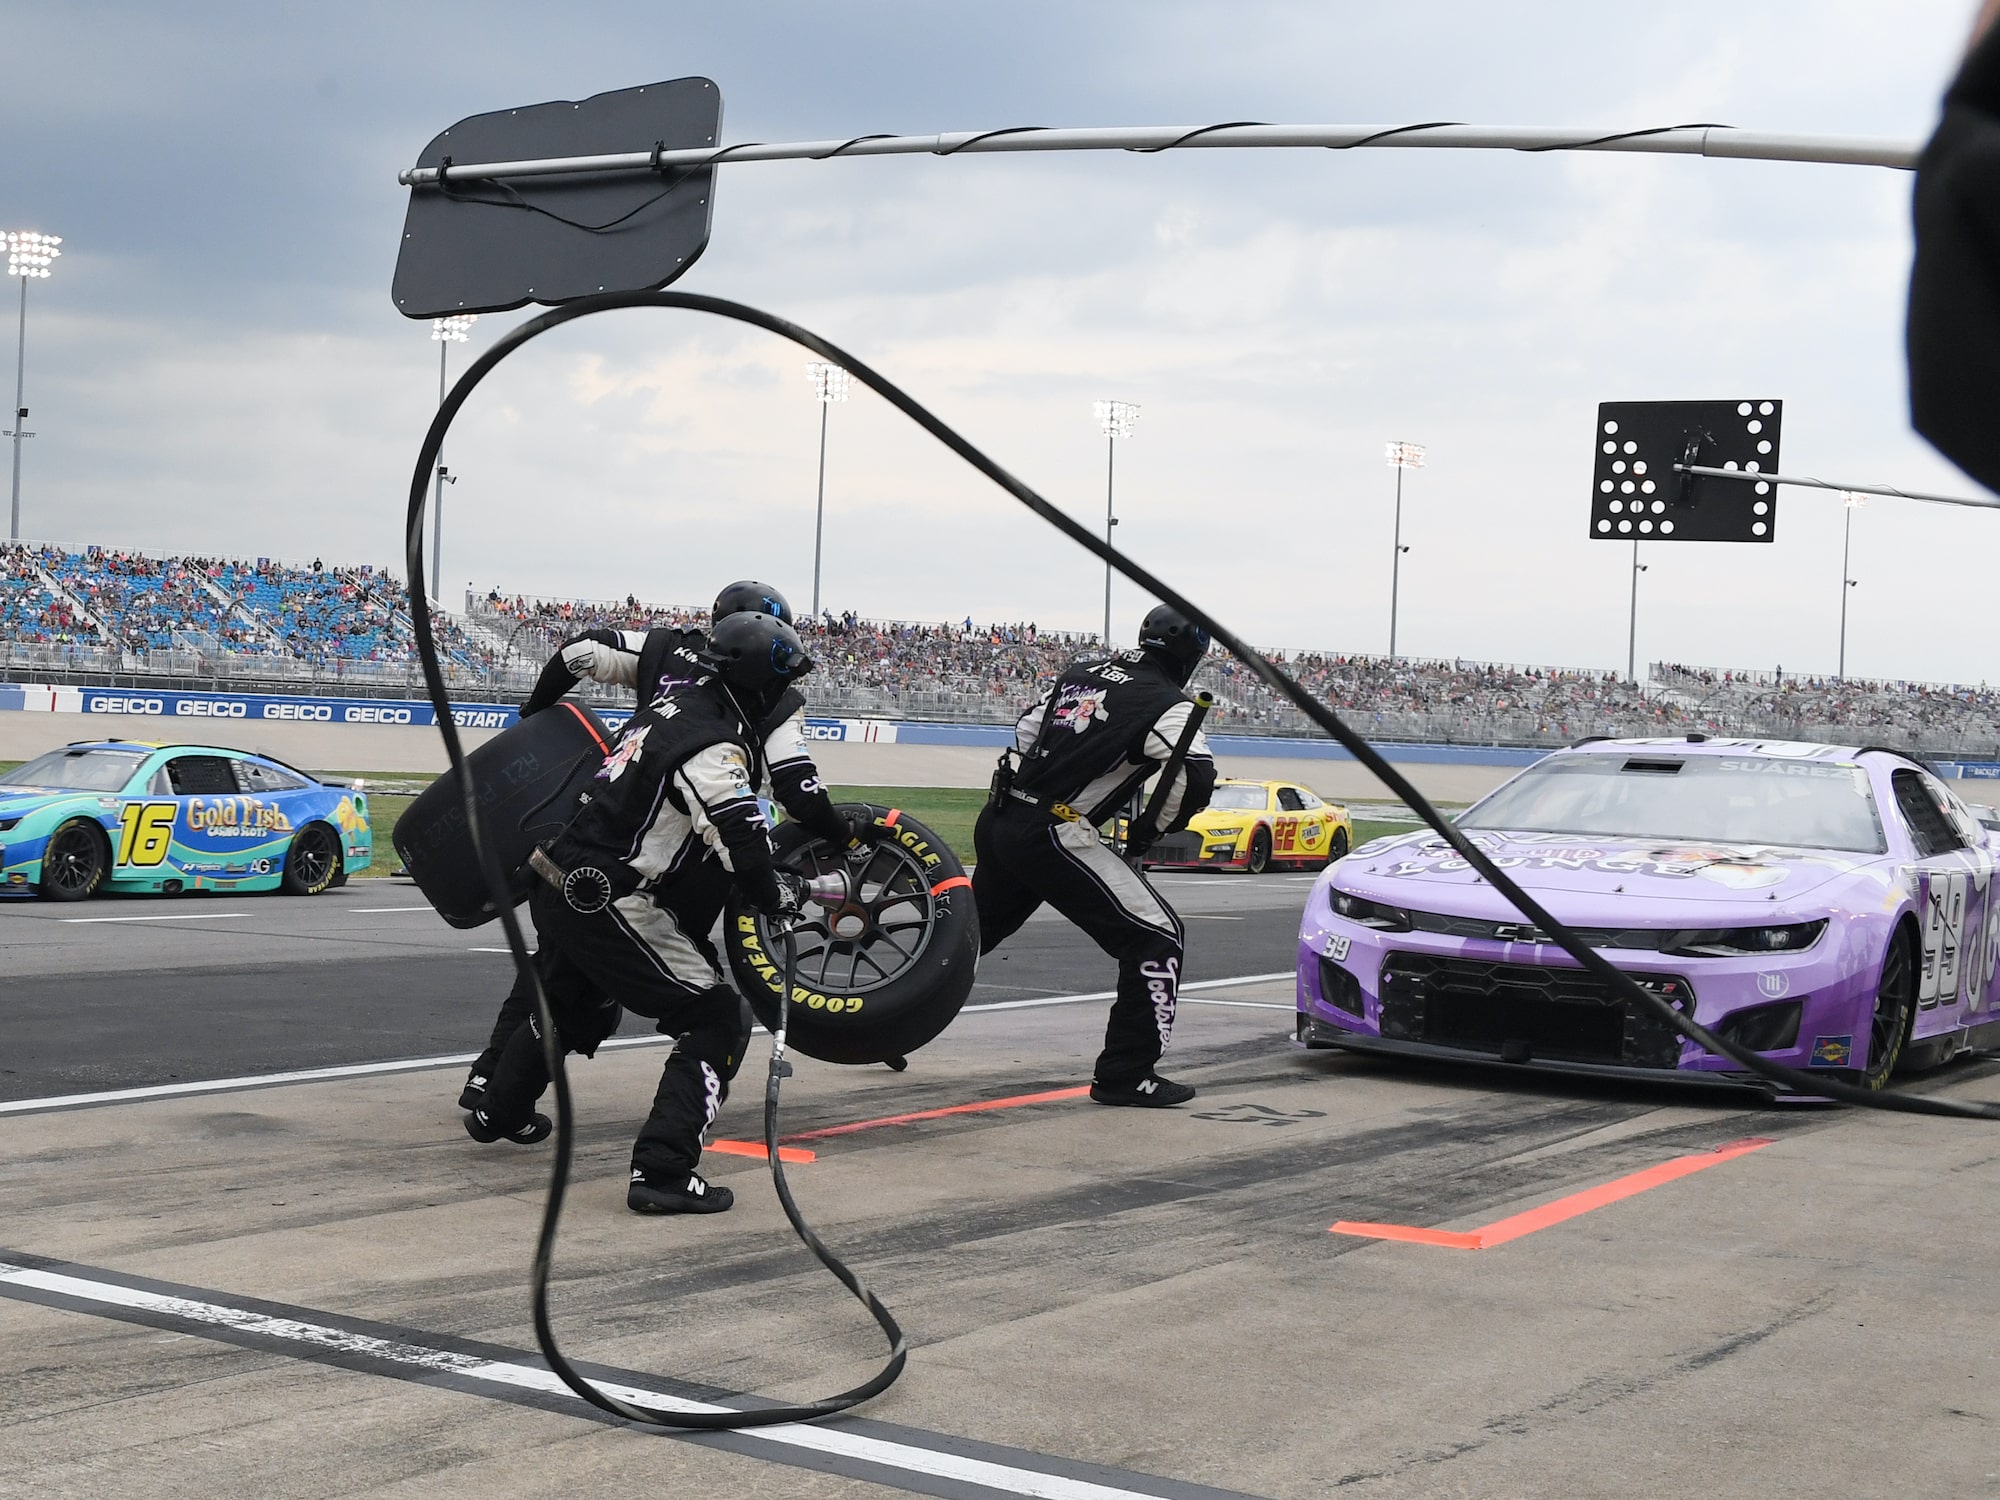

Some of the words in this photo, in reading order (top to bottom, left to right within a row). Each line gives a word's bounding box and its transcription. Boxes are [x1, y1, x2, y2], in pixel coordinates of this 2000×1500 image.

[90, 697, 163, 715] GEICO
[176, 700, 247, 718] GEICO
[263, 704, 332, 721] GEICO
[345, 707, 411, 724] GEICO
[803, 726, 842, 741] EICO
[1719, 761, 1851, 778] SUÁREZ
[187, 797, 238, 832] Gold
[238, 796, 295, 833] Fish
[115, 802, 179, 868] 16
[241, 826, 269, 838] SLOTS
[1273, 817, 1299, 850] 22
[1322, 934, 1353, 962] 99
[1917, 869, 1968, 1011] 99
